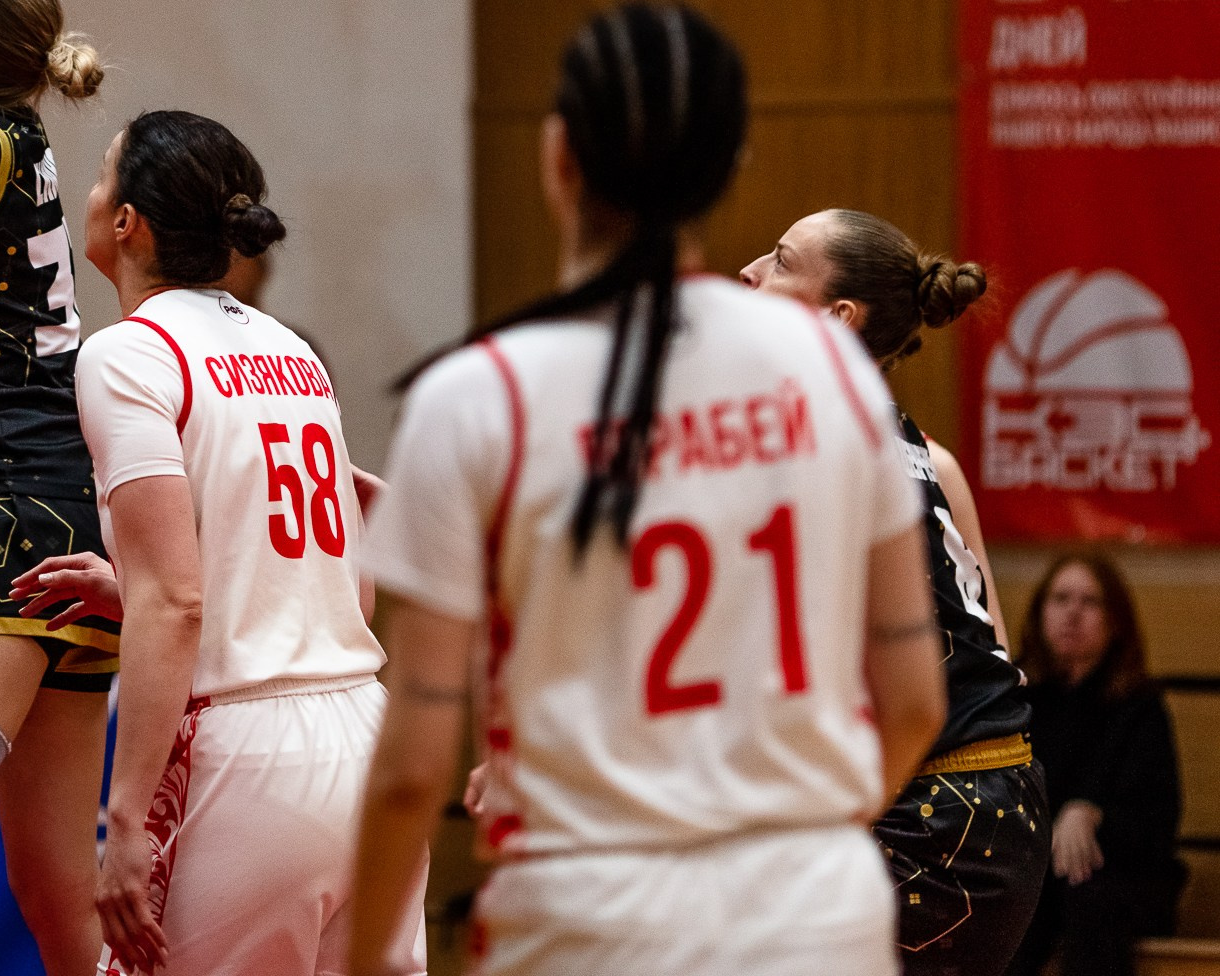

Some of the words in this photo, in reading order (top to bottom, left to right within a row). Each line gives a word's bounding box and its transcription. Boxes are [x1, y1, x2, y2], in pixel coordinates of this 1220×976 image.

[205, 353, 334, 402] СИЗЯКОВА
[576, 376, 817, 482] РАБЕЙ
[257, 422, 346, 560] 58
[630, 498, 810, 718] 21
